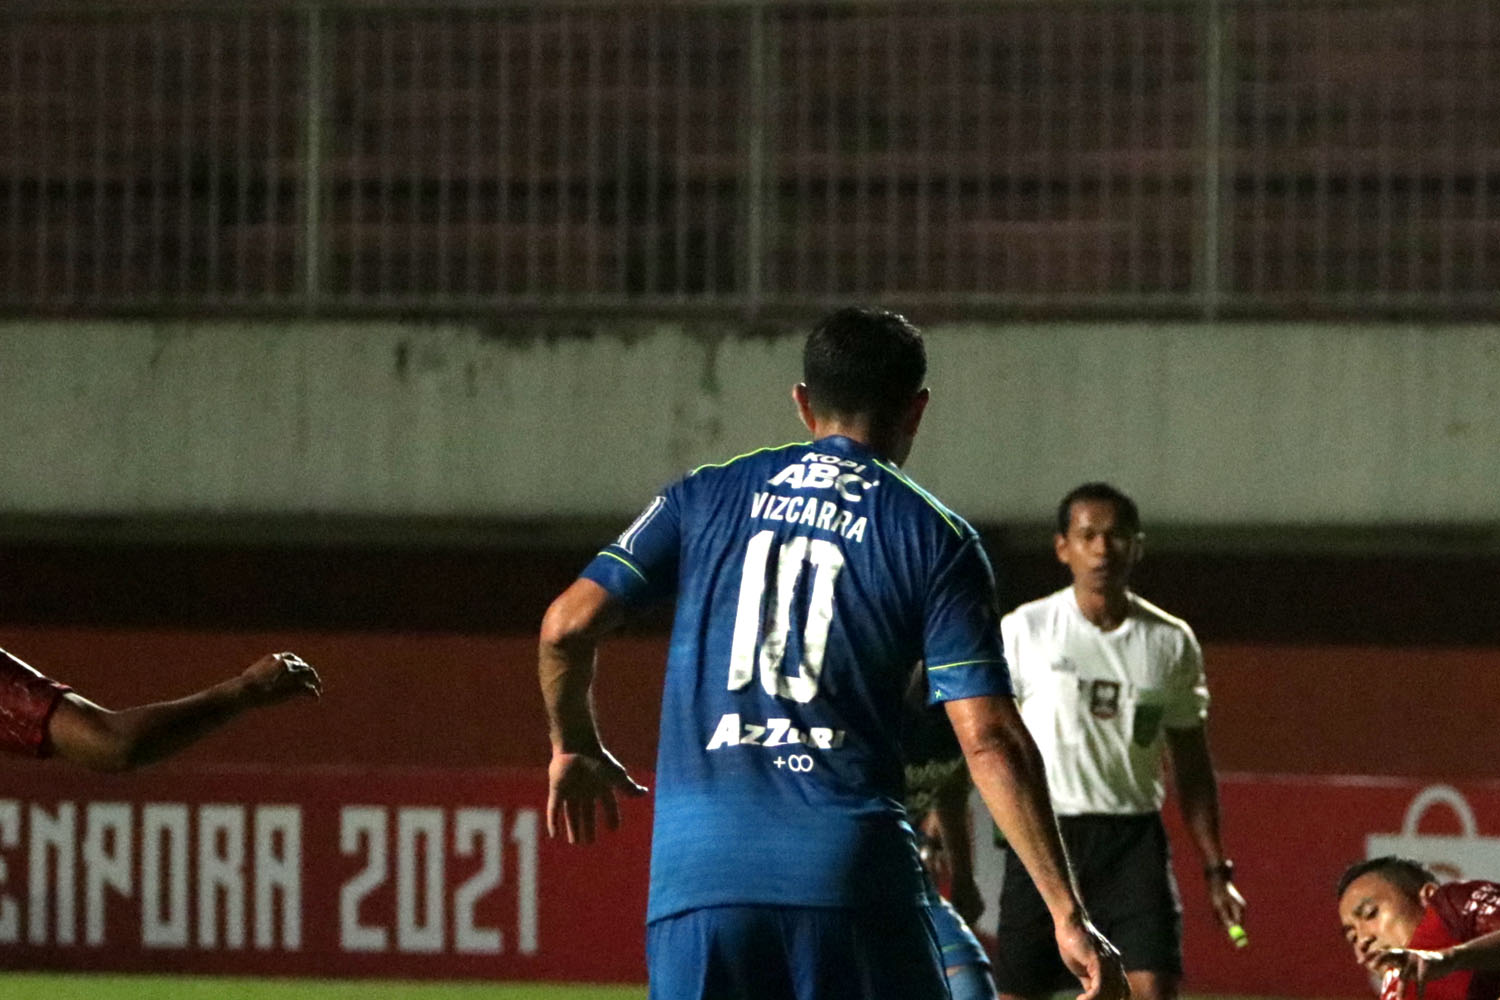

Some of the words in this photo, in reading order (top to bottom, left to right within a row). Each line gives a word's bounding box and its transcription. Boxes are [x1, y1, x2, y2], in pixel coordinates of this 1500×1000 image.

[767, 463, 880, 502] ABC
[801, 452, 867, 473] KOPI
[749, 492, 868, 543] VIZCARRA
[728, 530, 845, 703] 10
[339, 804, 538, 955] 2021
